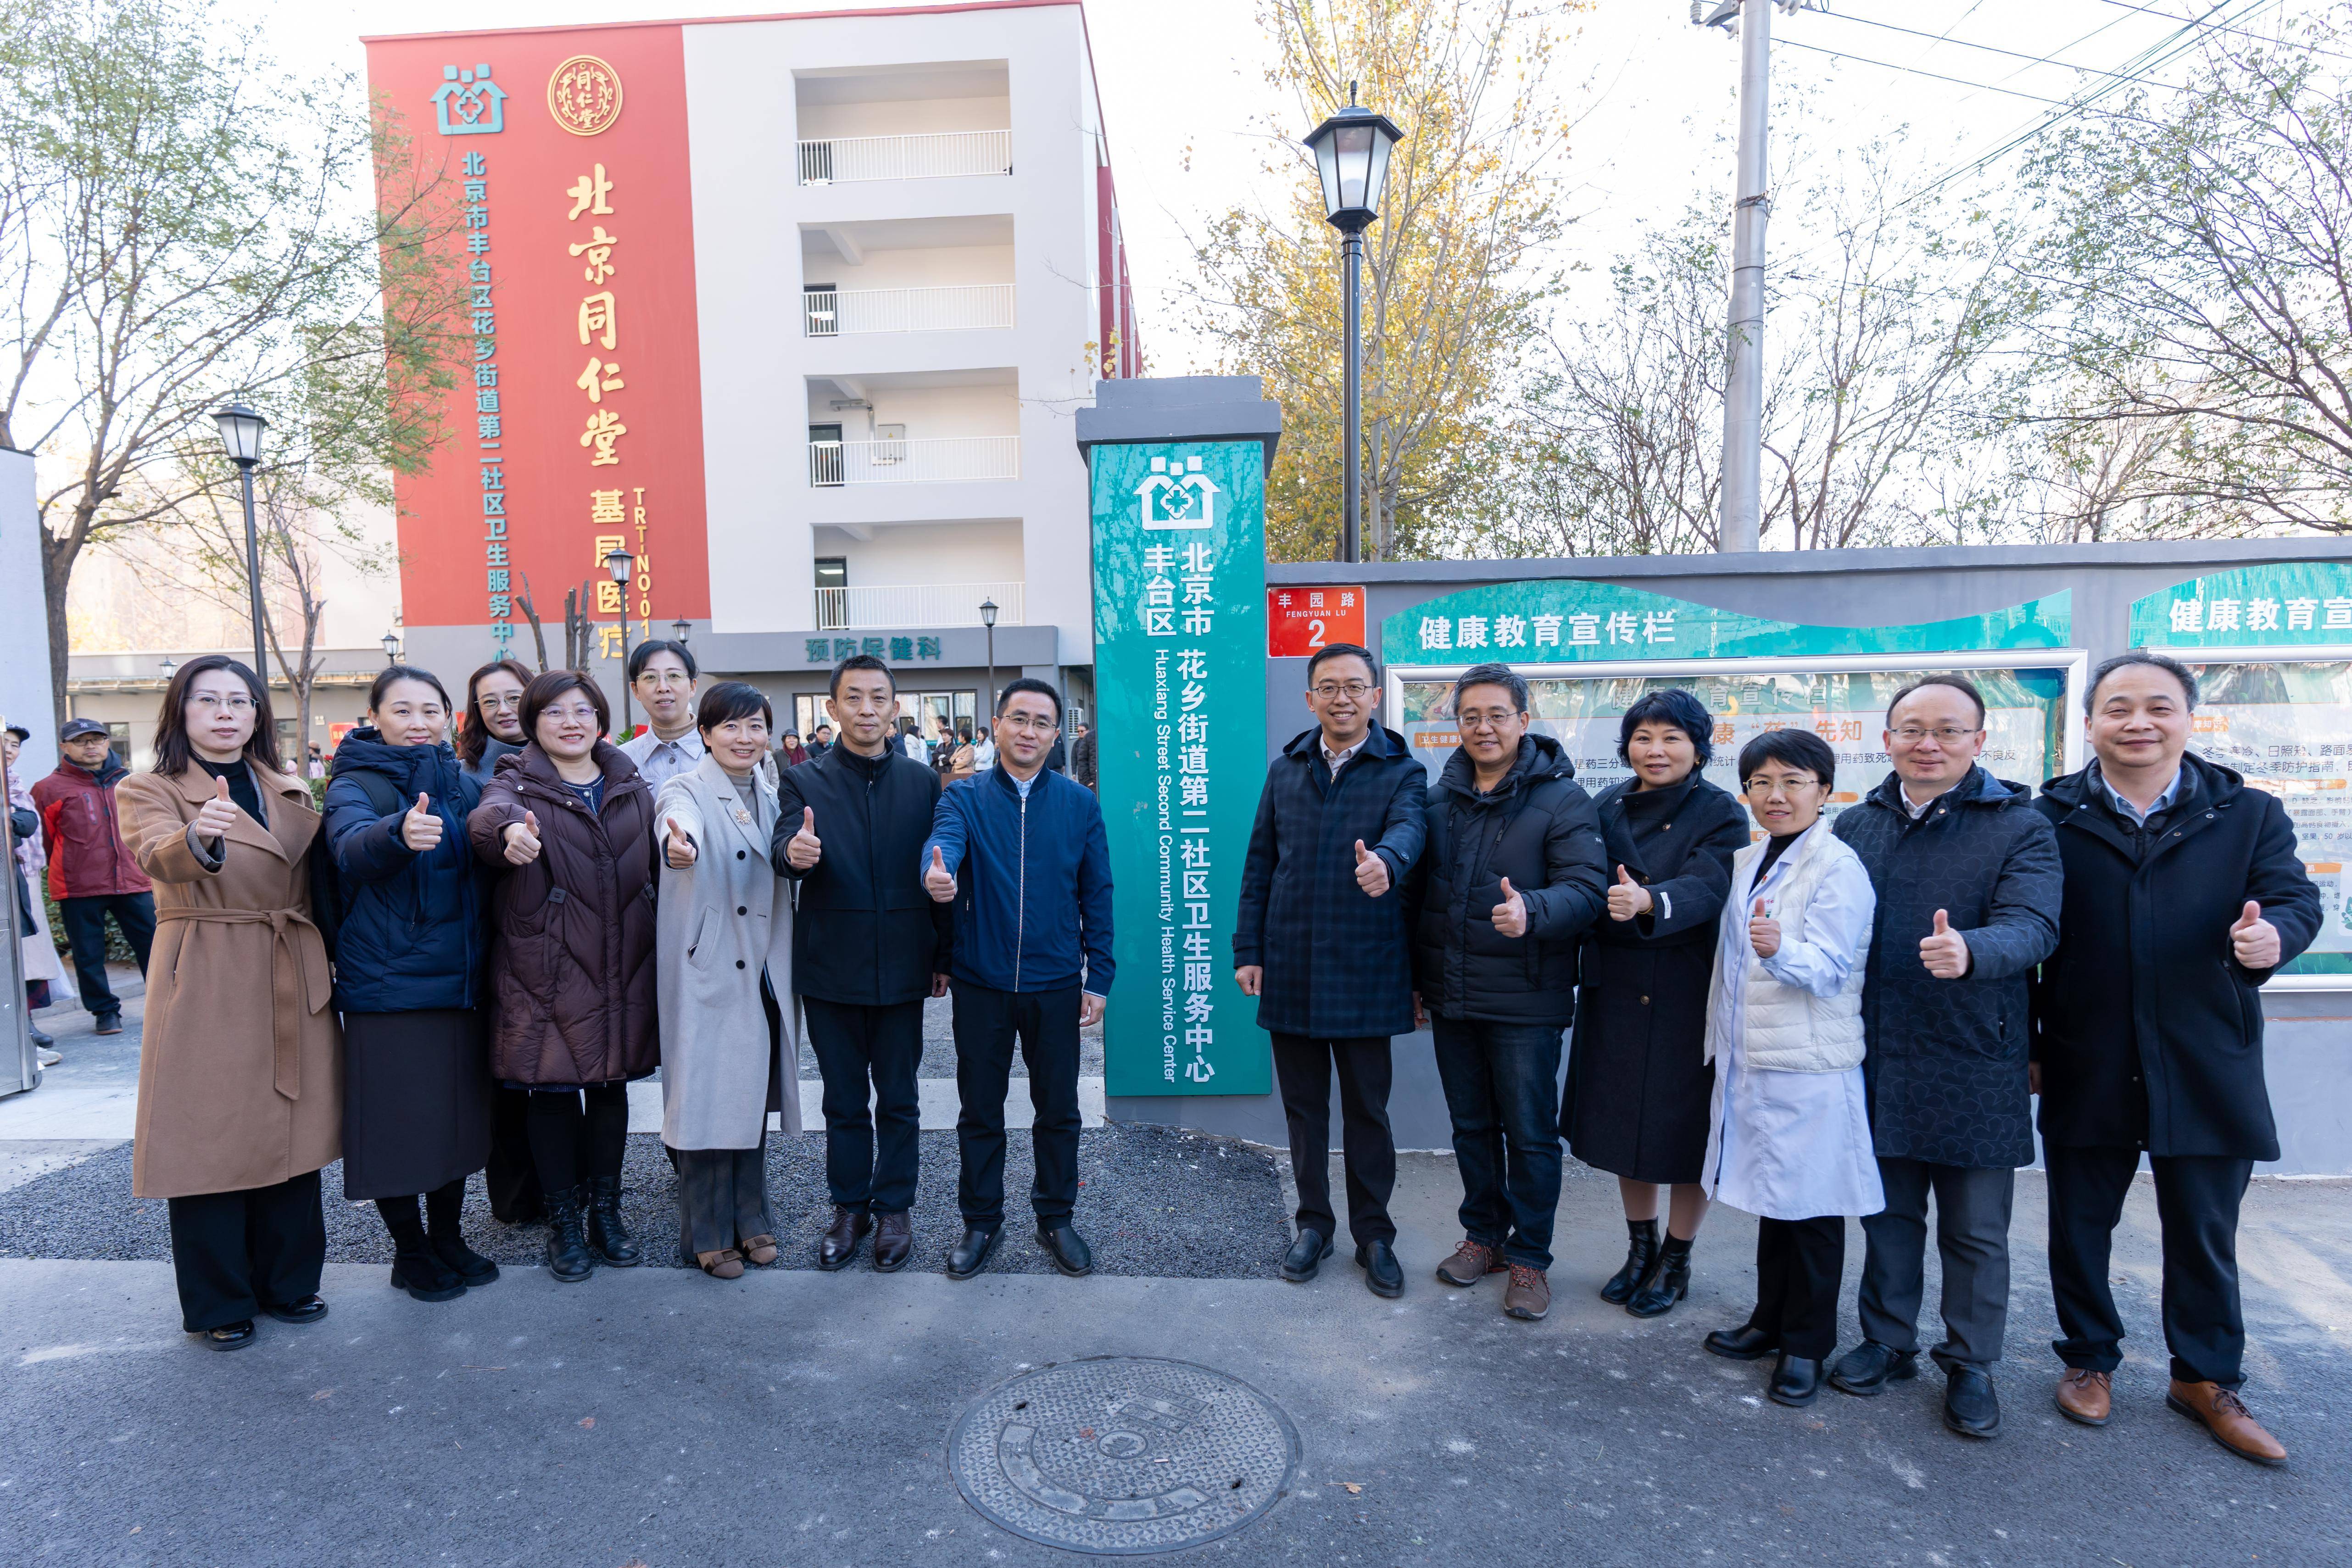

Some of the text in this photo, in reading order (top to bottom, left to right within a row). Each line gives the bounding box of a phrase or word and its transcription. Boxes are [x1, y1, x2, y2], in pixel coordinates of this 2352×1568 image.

[576, 69, 596, 128] 同仁堂
[566, 162, 628, 466] 北京同仁堂
[1143, 544, 1177, 636] 丰台区
[1180, 542, 1215, 636] 北京市
[1278, 592, 1354, 608] 丰园路
[2168, 596, 2352, 633] 健康教育宣
[805, 636, 942, 662] 预防保健科
[1309, 619, 1325, 647] 2
[1419, 611, 1676, 650] 健康教育宣传栏
[1154, 649, 1177, 1083] Huaxiang Street Second Community Health Service Center
[1176, 649, 1215, 1083] 花乡街道第二社区卫生服务中心
